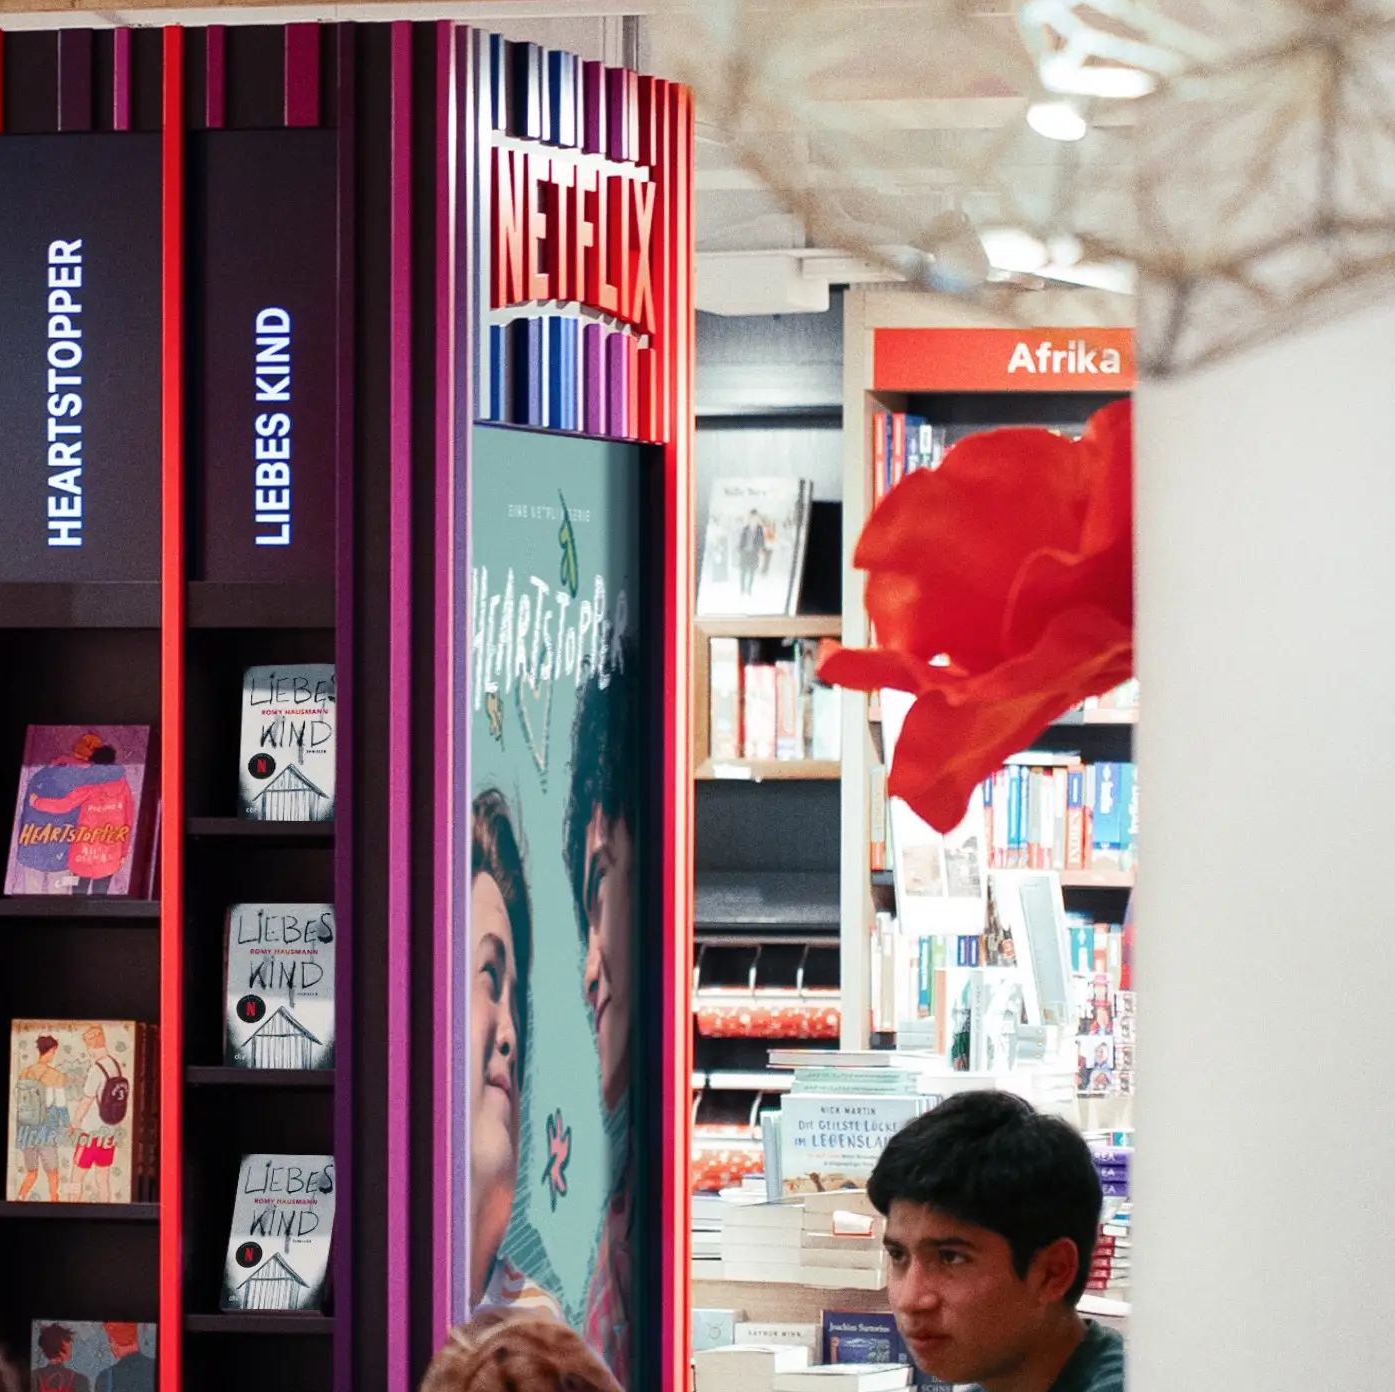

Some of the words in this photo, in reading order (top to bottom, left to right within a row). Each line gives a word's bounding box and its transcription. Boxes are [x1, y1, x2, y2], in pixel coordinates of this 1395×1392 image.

[494, 146, 656, 334] NETFLIX
[255, 307, 291, 402] KIND
[1007, 339, 1120, 374] Afrika
[47, 238, 83, 546] HEARTSTOPPER
[255, 412, 291, 545] LIEBES
[472, 565, 628, 711] HEARTSTOPPER
[260, 716, 332, 749] KIND
[19, 823, 129, 846] HEARTSTOPPER
[237, 909, 334, 944] LIEBES
[249, 956, 324, 989] KIND
[798, 1120, 814, 1131] DIE
[818, 1120, 861, 1131] GEILSTE
[820, 1107, 842, 1115] NICK
[844, 1107, 876, 1115] MARTIN
[794, 1137, 807, 1147] IM
[244, 1160, 334, 1194] LIEBES
[250, 1205, 320, 1237] KIND
